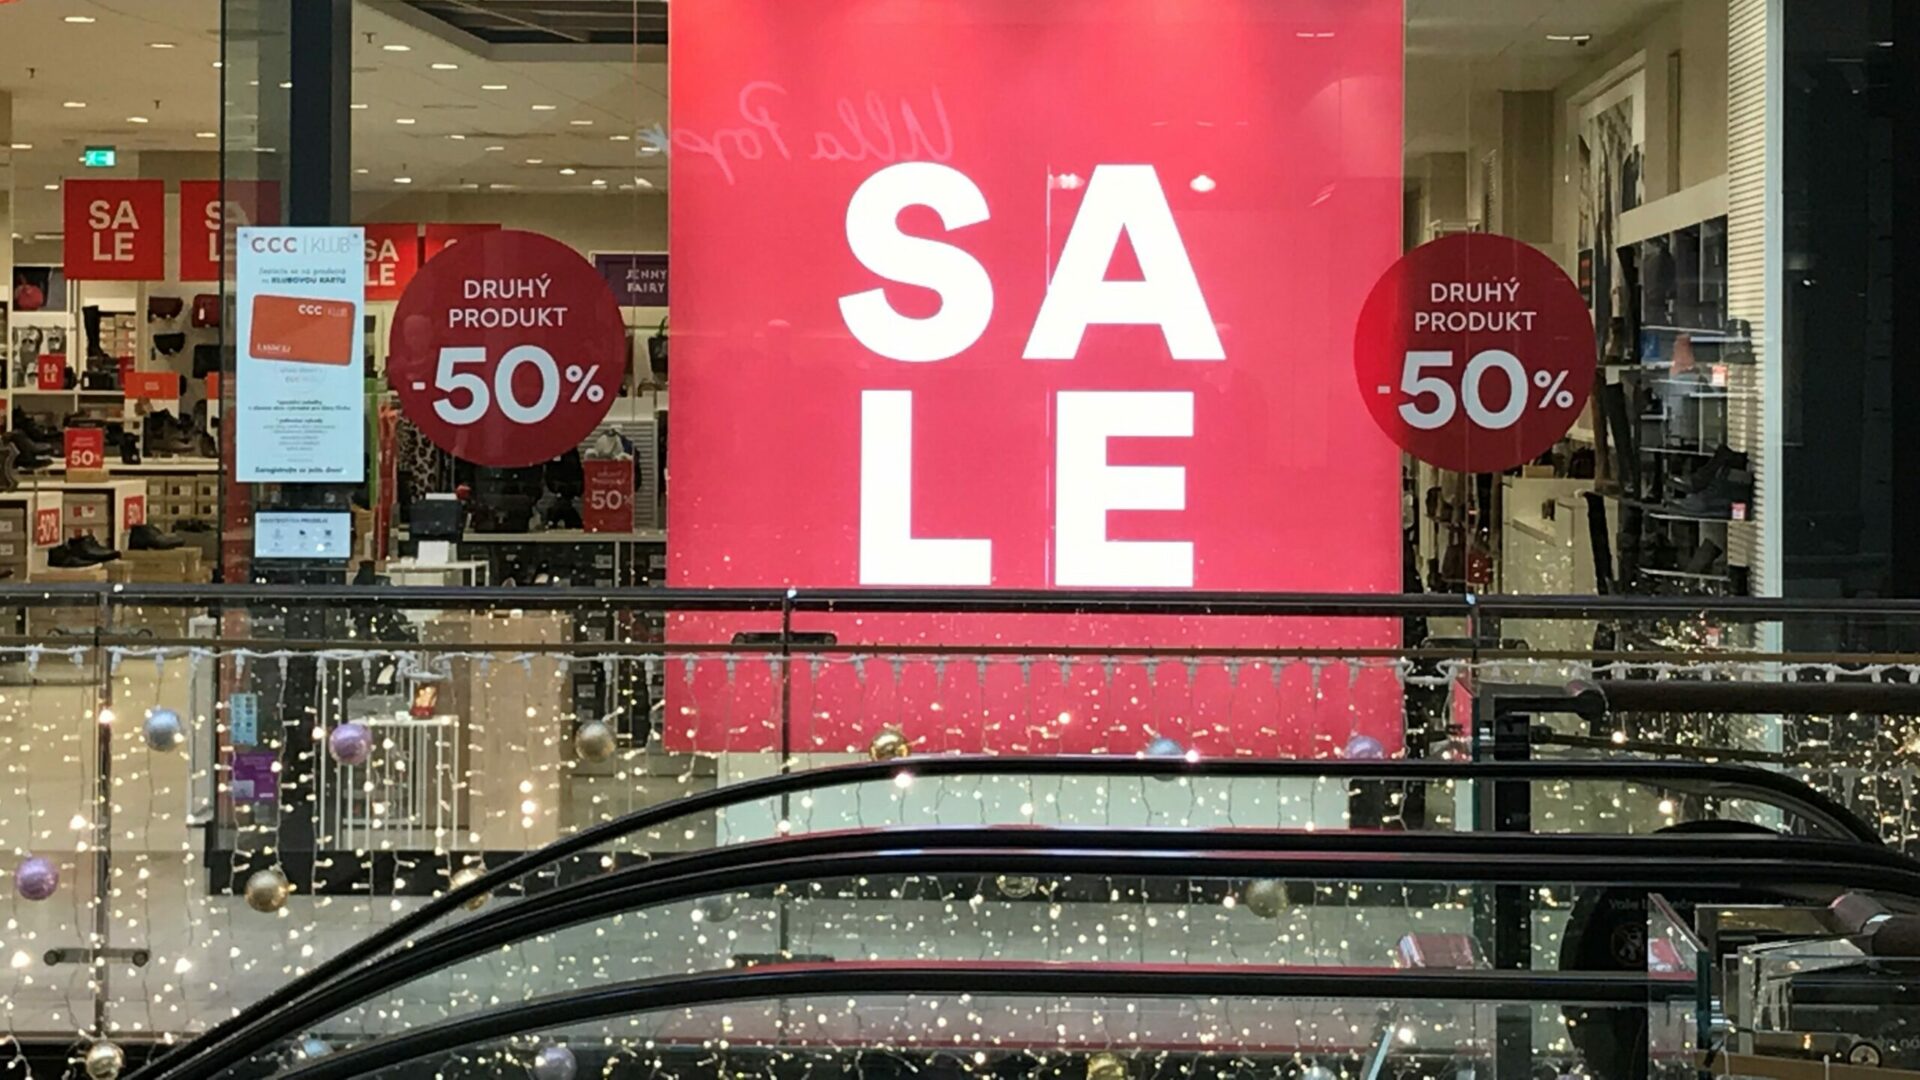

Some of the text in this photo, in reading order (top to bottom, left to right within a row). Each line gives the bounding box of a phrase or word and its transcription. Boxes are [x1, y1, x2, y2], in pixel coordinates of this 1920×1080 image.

[88, 199, 140, 230] SA
[92, 231, 135, 262] LE
[251, 237, 297, 253] CCC
[625, 268, 668, 280] JENNY
[838, 161, 1227, 362] SA
[365, 263, 396, 287] LE
[463, 273, 552, 299] DRUHÝ
[627, 282, 665, 294] FAIRY
[1430, 276, 1520, 302] DRUHÝ
[298, 304, 322, 315] CCC
[448, 307, 568, 329] PRODUKT
[1415, 311, 1538, 332] PRODUKT
[412, 344, 605, 426] -50%
[1376, 349, 1574, 430] -50%
[859, 389, 1195, 588] LE
